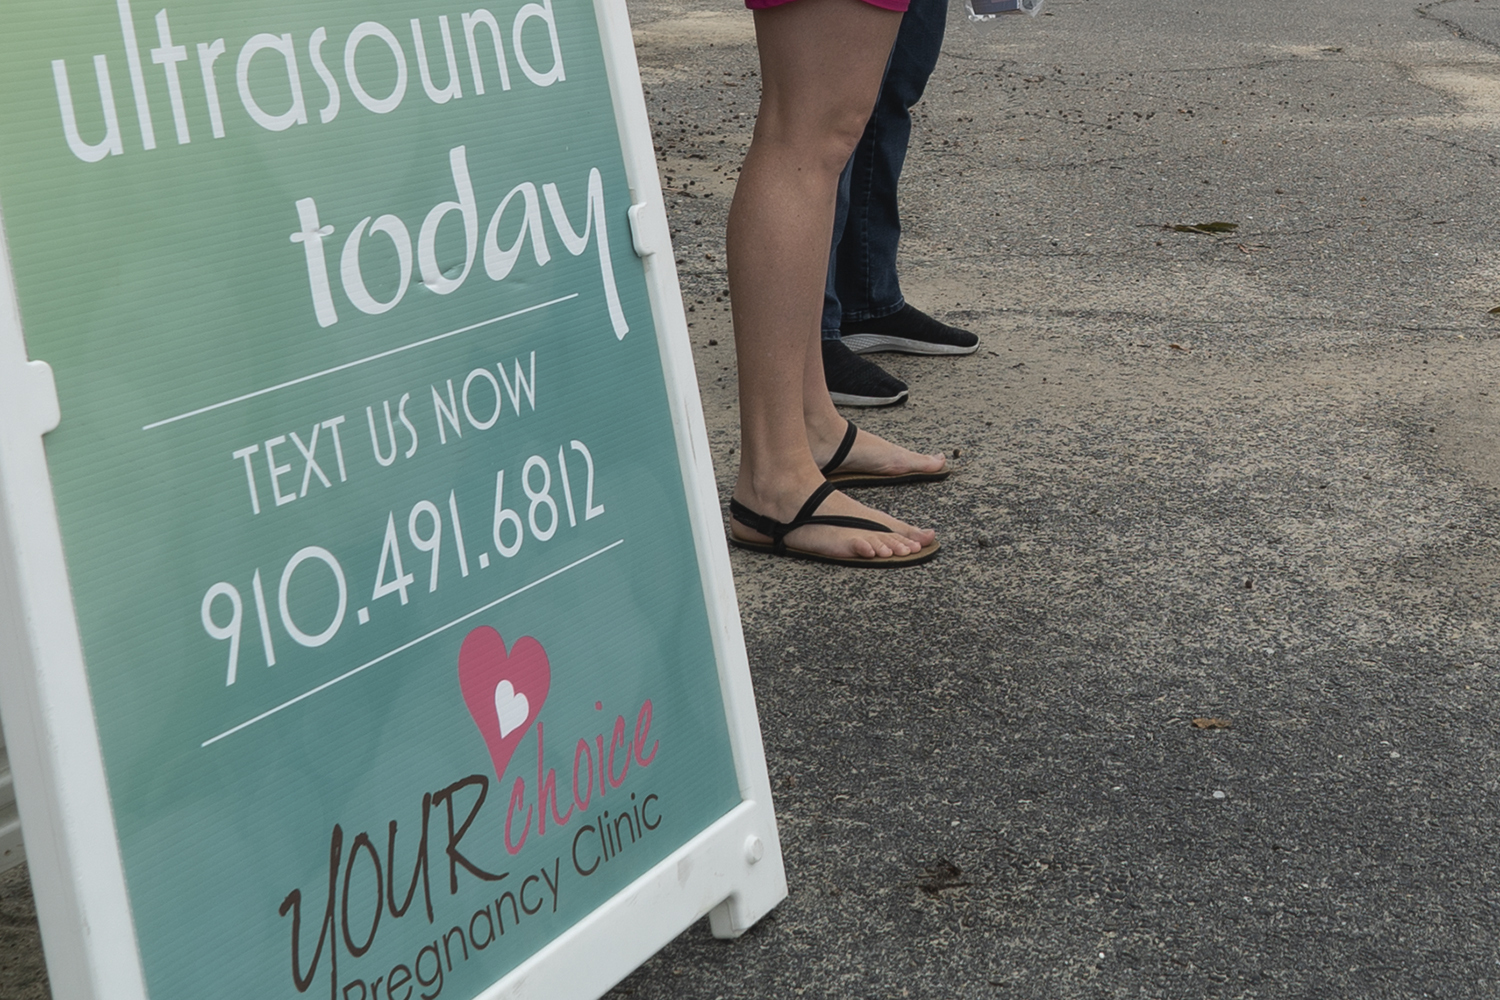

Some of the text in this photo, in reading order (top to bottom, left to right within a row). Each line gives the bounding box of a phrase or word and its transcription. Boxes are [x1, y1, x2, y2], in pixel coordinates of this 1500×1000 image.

[290, 145, 630, 340] today
[232, 351, 537, 515] TEXT US NOW
[201, 440, 606, 687] 910.491.6812
[505, 699, 660, 855] choice
[343, 792, 662, 1000] Pregnancy Clinic
